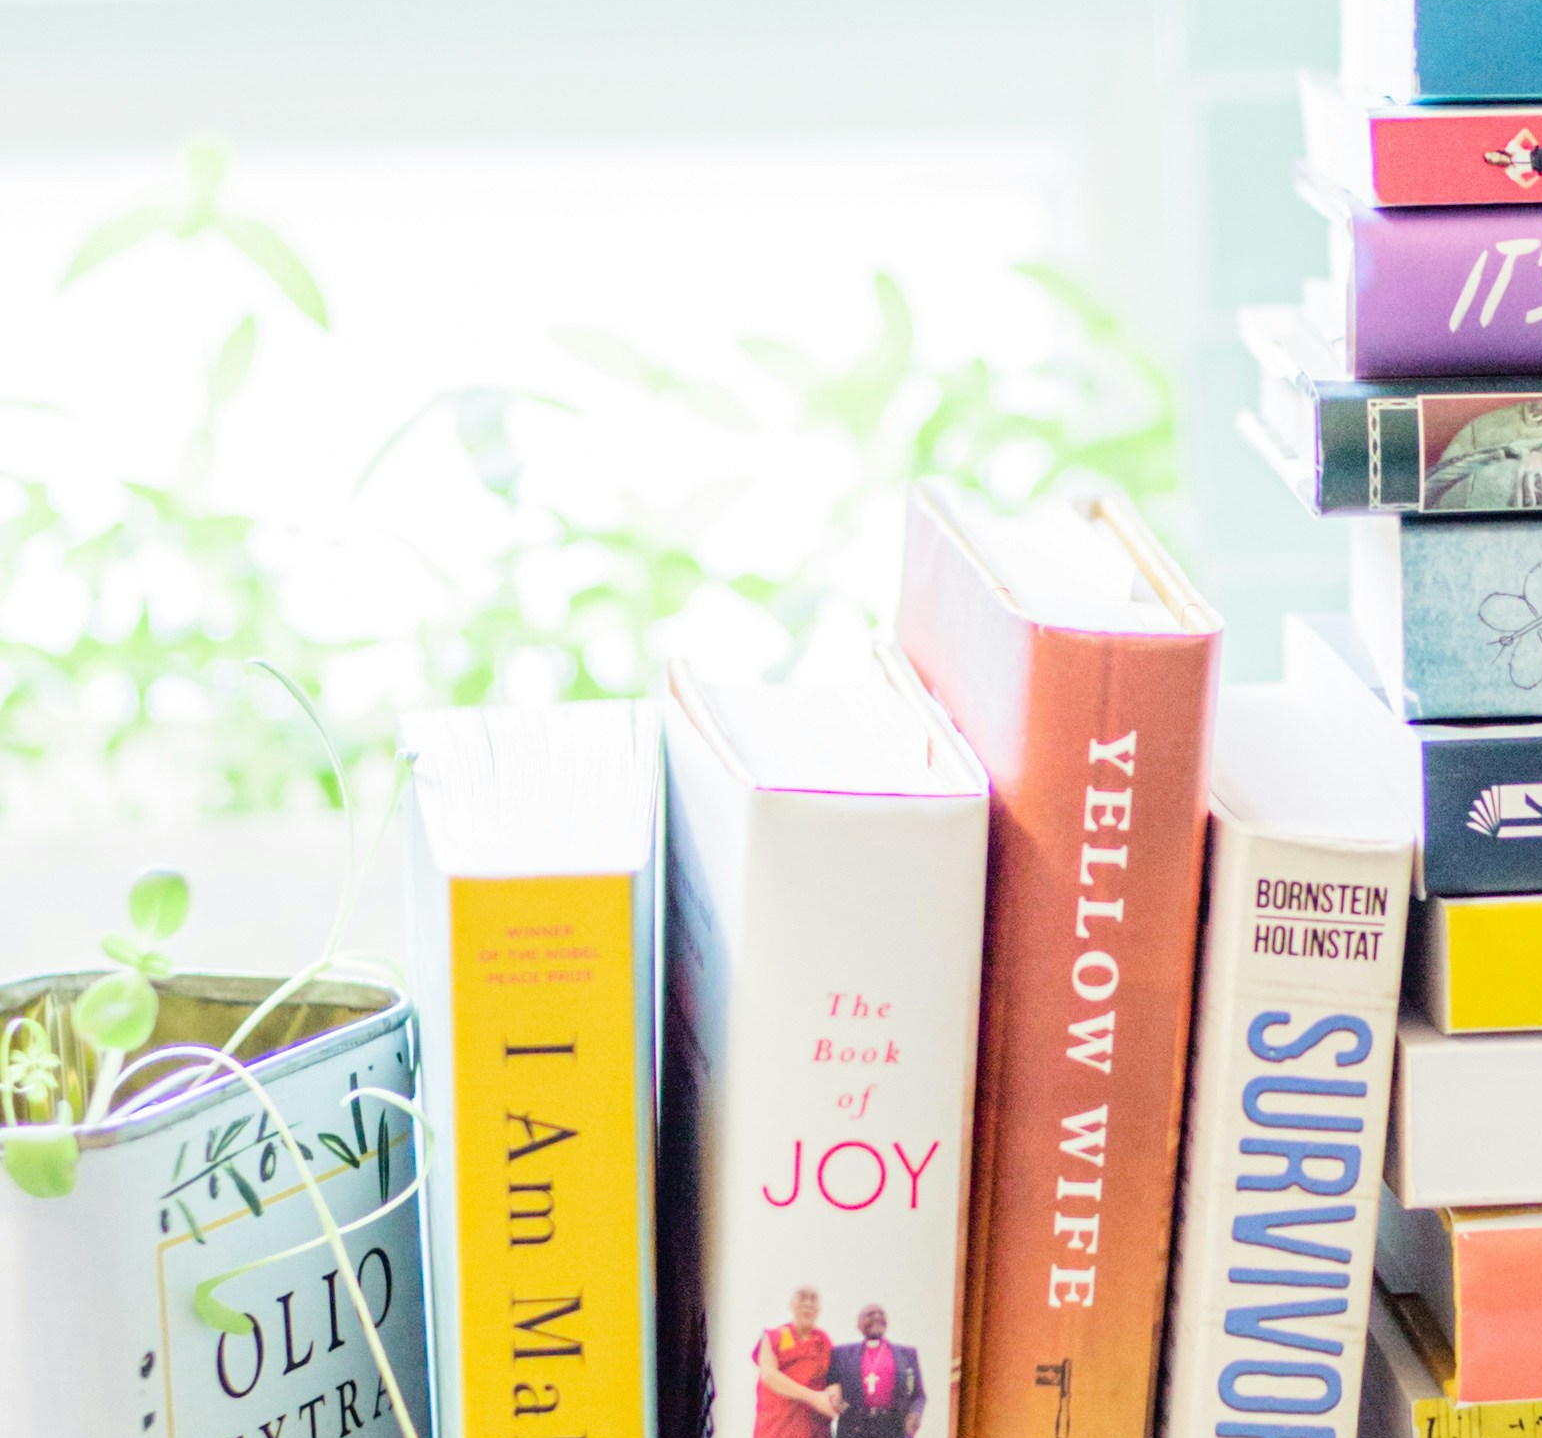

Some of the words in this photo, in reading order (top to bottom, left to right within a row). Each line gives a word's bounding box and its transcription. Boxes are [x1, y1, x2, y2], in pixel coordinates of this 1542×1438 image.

[1066, 729, 1138, 1074] YELLOW
[1256, 878, 1388, 918] BORNSTEIN
[1254, 925, 1384, 962] HOLINSTAT
[828, 993, 893, 1020] The
[503, 1033, 578, 1065] I
[813, 1038, 901, 1065] Book
[837, 1085, 878, 1120] of
[505, 1110, 581, 1251] Am
[762, 1139, 940, 1210] JOY
[1047, 1104, 1109, 1309] WIFE
[216, 1247, 392, 1398] OLIO
